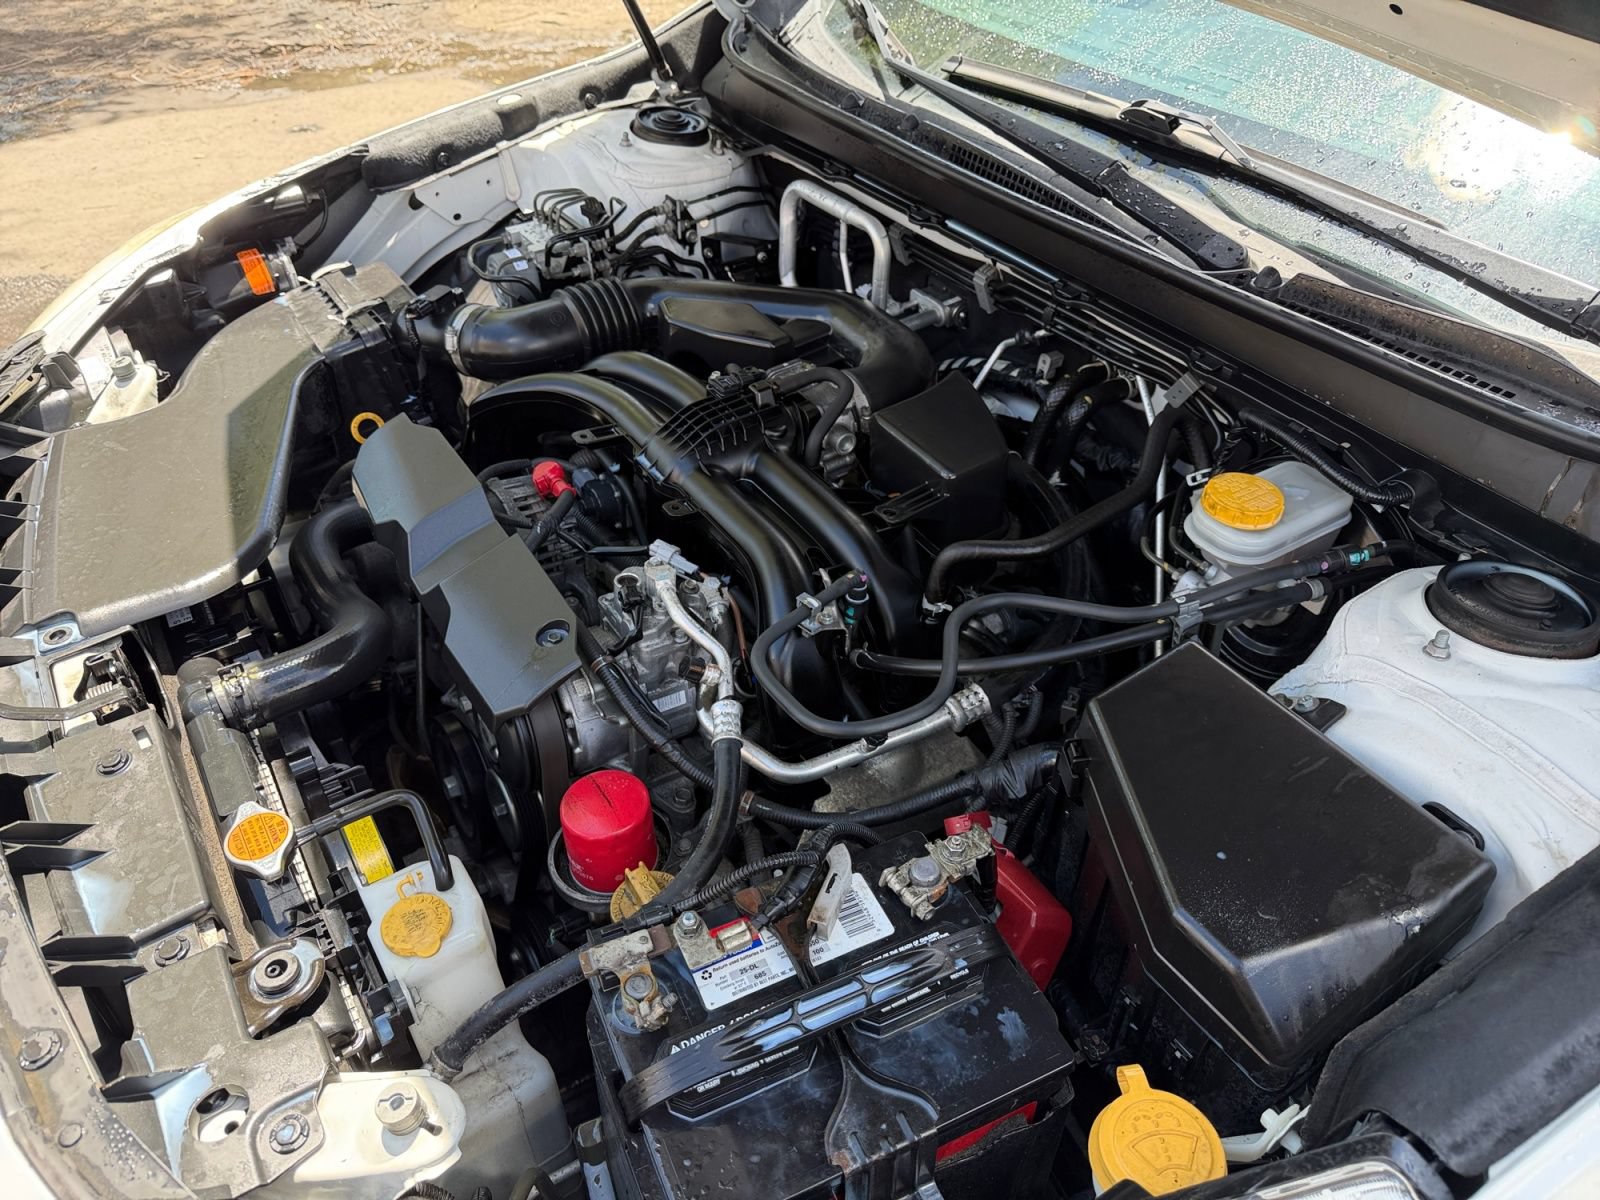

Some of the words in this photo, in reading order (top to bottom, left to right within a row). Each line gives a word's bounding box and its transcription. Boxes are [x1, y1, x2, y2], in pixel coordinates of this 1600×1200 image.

[919, 931, 941, 945] CHILDREN
[812, 947, 824, 955] 100
[712, 963, 728, 973] Return
[728, 958, 740, 966] used
[740, 951, 759, 961] batteries
[739, 963, 759, 975] 25-DL
[754, 970, 767, 980] 685
[680, 1024, 726, 1050] DANGER
